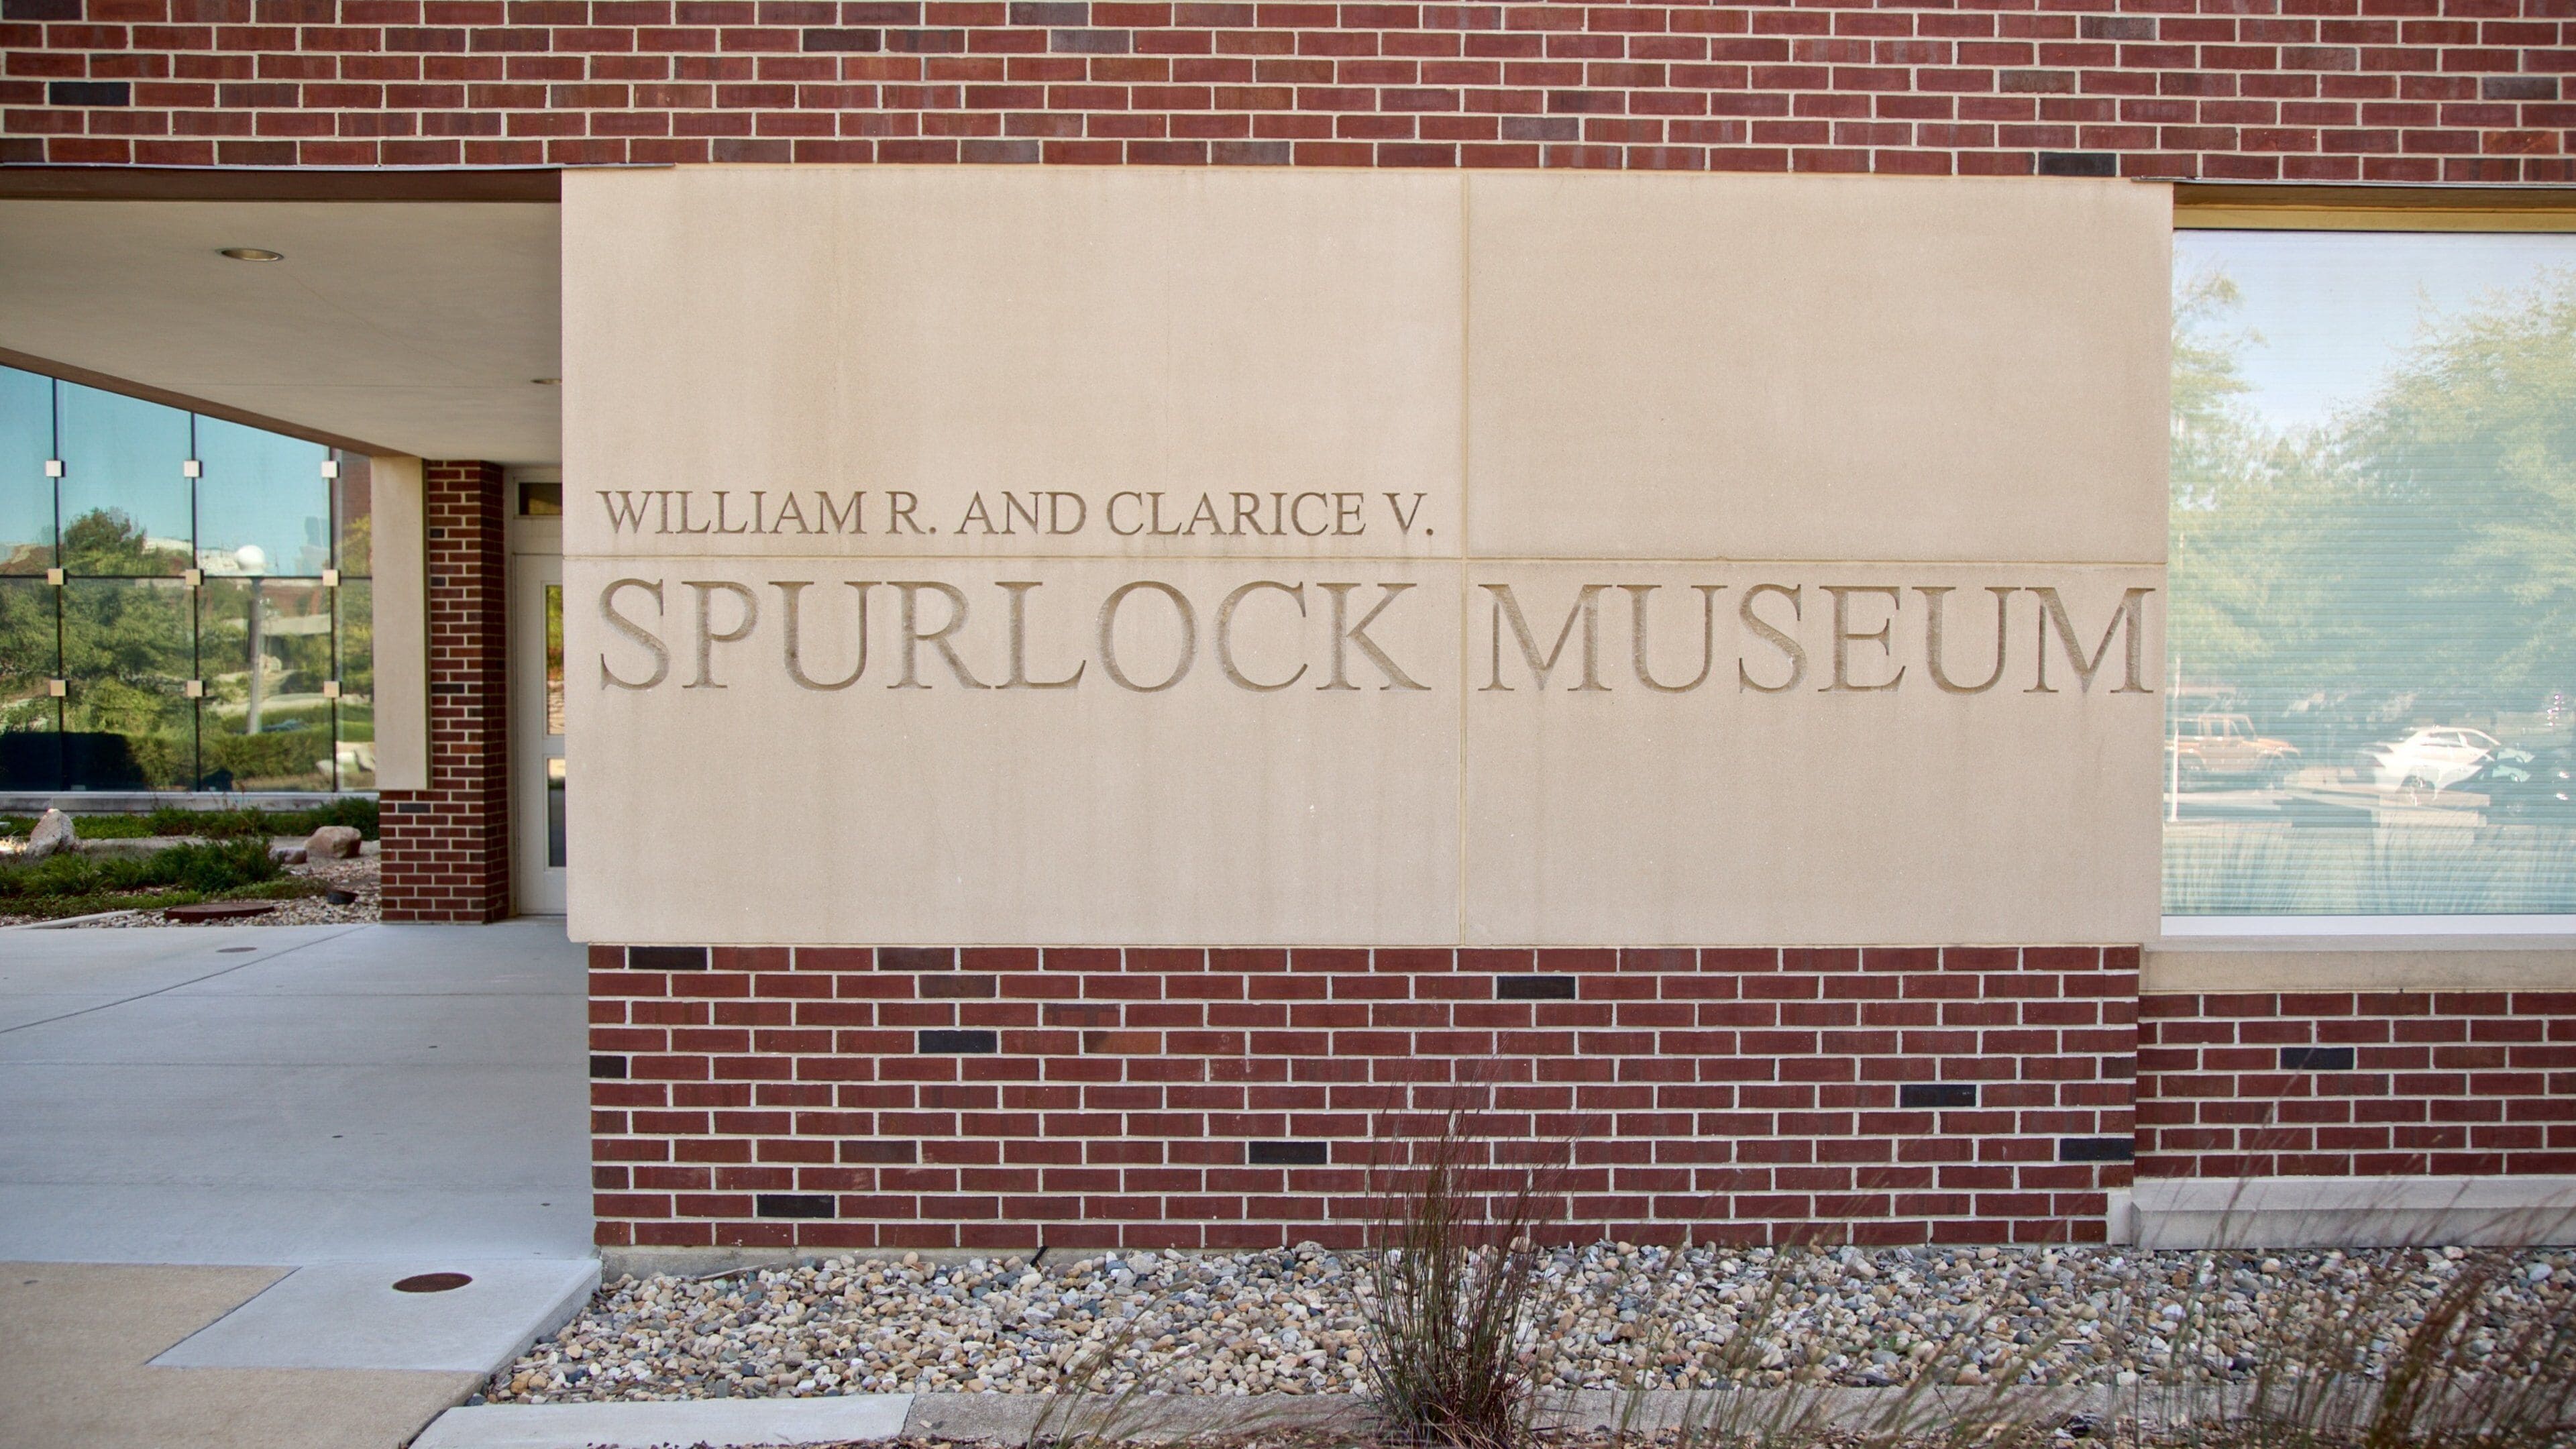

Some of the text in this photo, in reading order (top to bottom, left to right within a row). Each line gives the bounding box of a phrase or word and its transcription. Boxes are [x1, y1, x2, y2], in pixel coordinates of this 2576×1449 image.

[596, 490, 1434, 536] WILLIAM R. AND CLARICE V.
[598, 578, 2156, 694] SPURLOCK MUSEUM
